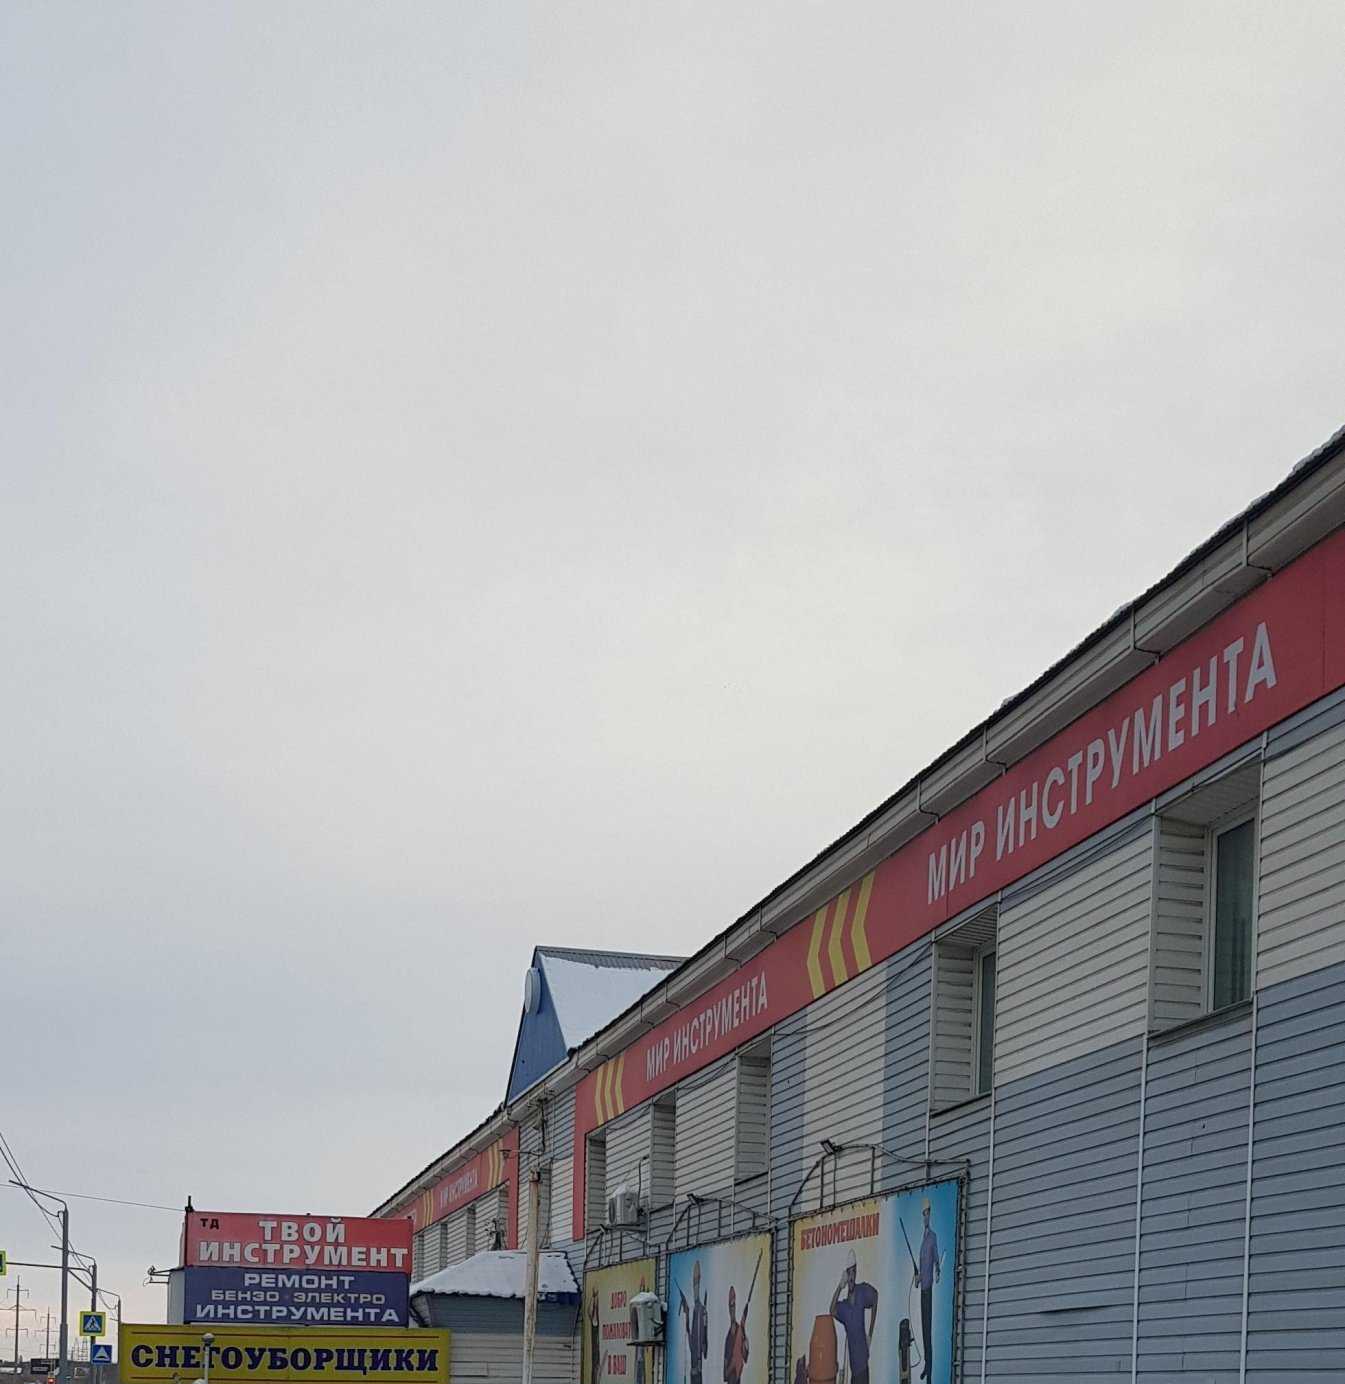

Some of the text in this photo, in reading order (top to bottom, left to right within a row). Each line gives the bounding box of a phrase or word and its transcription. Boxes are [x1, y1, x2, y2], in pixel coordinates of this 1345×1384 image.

[927, 621, 1277, 905] МИР ИНСТРУМЕНТА
[646, 970, 768, 1081] МИР ИНСТРУМЕНТА
[200, 1218, 220, 1230] ТД
[258, 1217, 346, 1243] ТВОЙ
[800, 1212, 880, 1251] БЕТОНОМЕШАЛКИ
[199, 1241, 409, 1268] ИНСТРУМЕНТ
[244, 1272, 355, 1290] РЕМОНТ
[211, 1289, 386, 1305] БЕНЗО ЭЛЕКТРО
[196, 1304, 400, 1323] ИНСТРУМЕНТА
[130, 1344, 440, 1376] СНЕГОУБОРЩИКИ
